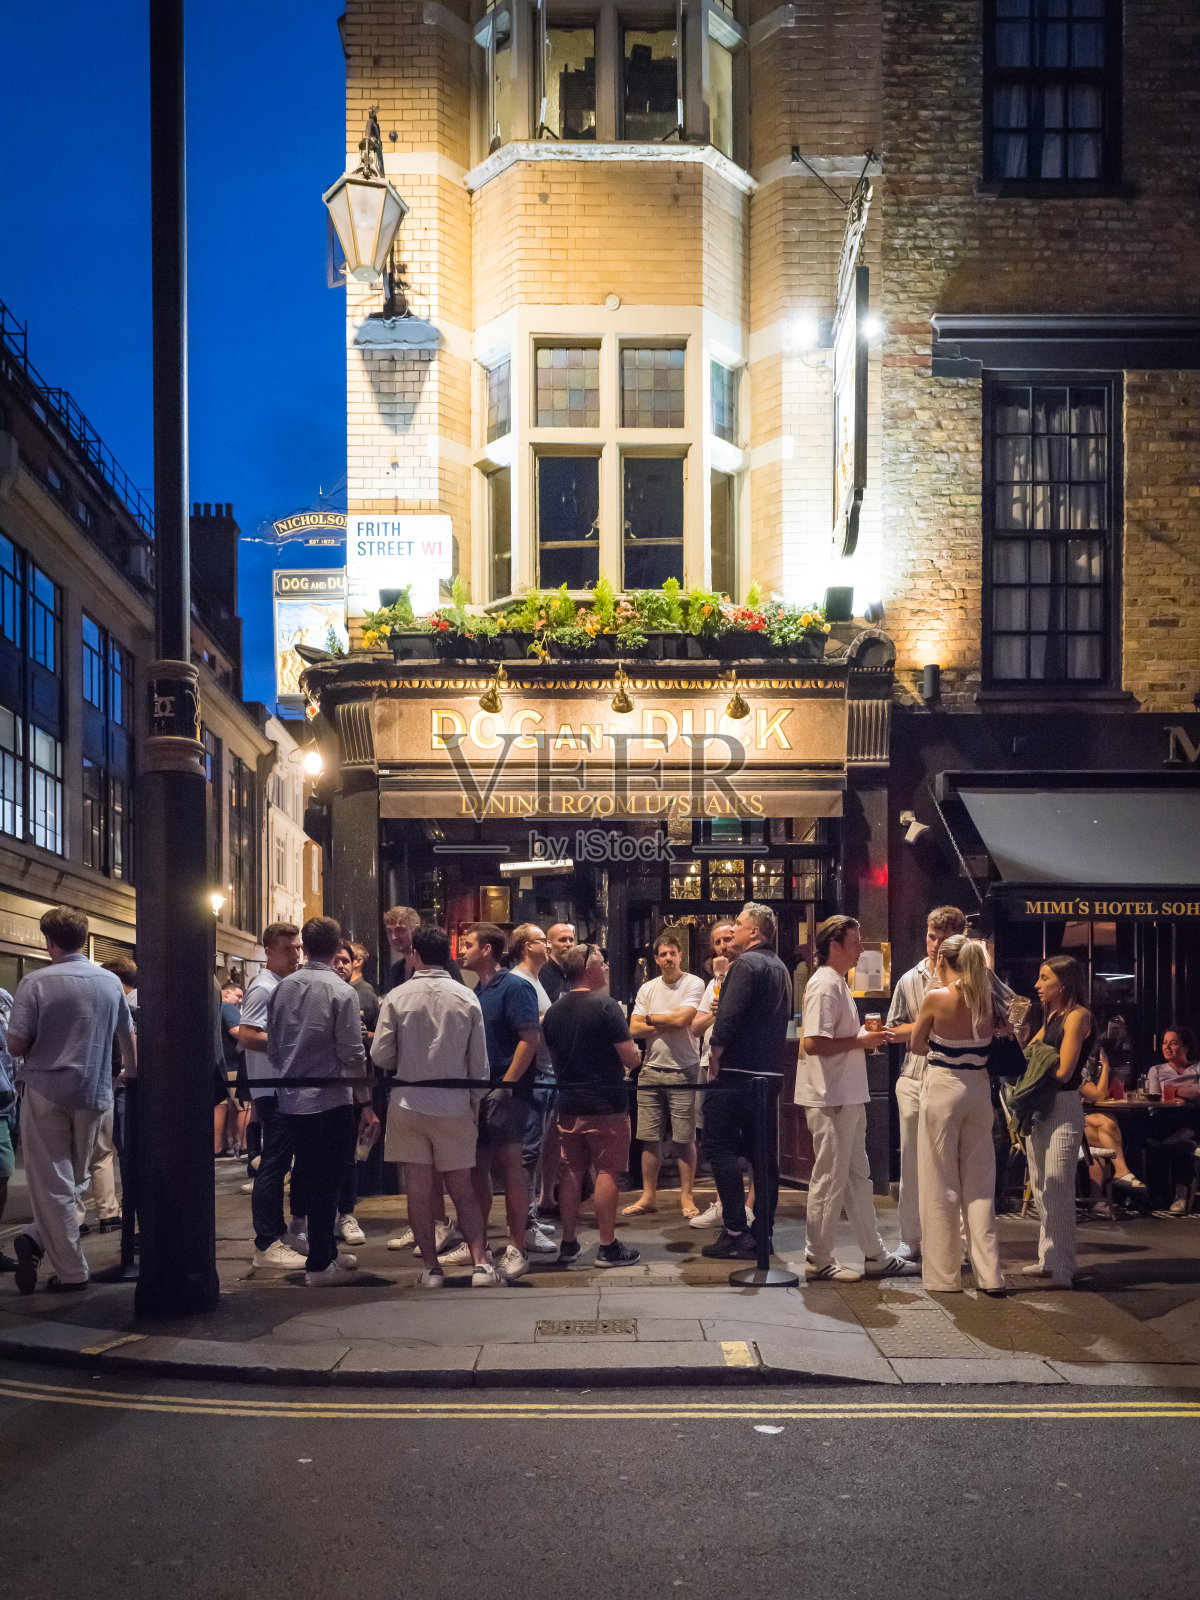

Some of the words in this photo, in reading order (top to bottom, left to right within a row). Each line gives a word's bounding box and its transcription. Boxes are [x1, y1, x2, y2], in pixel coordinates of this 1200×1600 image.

[276, 514, 347, 533] NICHOLSO
[357, 522, 401, 537] FRITH
[357, 541, 415, 556] STREET
[421, 541, 442, 556] W1
[281, 577, 310, 590] DOG
[310, 581, 327, 590] AND
[431, 708, 546, 750] DOG
[553, 723, 633, 750] AND
[641, 707, 796, 750] DUCK
[460, 795, 552, 814] DINING
[561, 795, 636, 814] ROOM
[645, 794, 764, 814] UPSTAIRS
[1093, 902, 1159, 915] HOTEL
